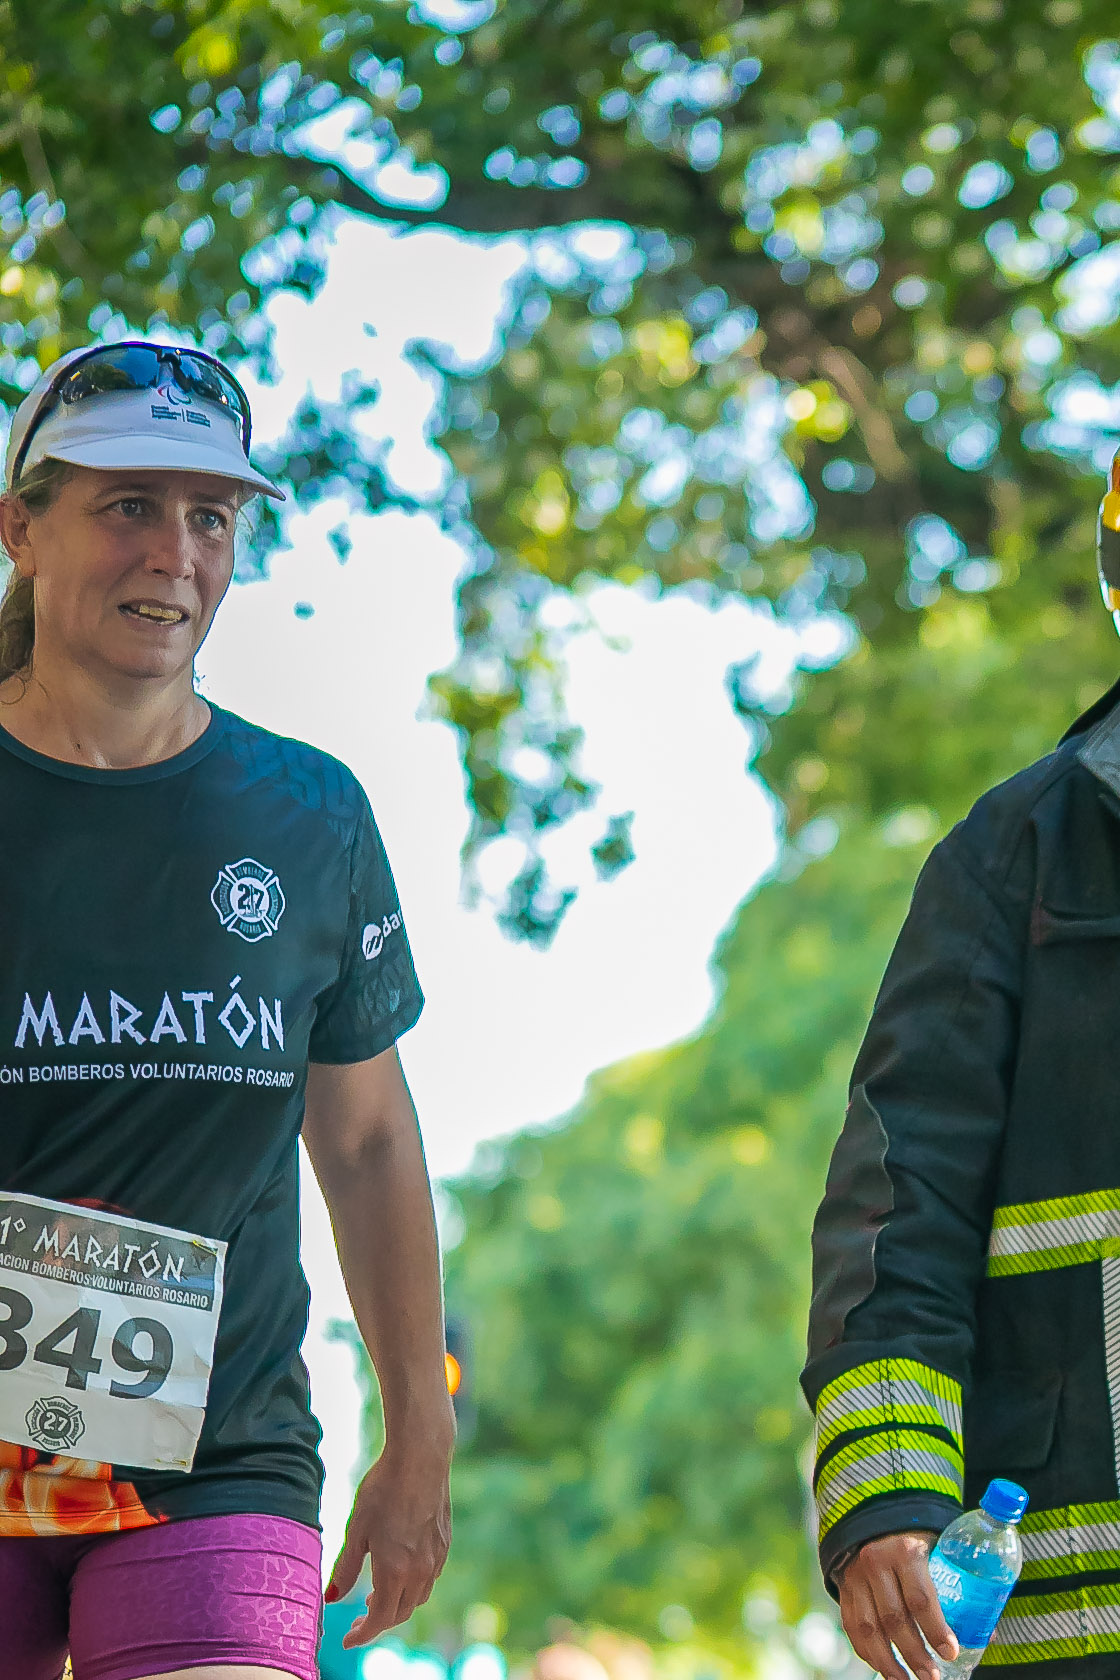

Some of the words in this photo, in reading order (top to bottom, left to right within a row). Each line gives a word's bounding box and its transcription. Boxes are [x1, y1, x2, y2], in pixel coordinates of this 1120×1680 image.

[14, 975, 285, 1051] MARATÓN
[29, 1063, 125, 1083] BOMBEROS
[130, 1062, 243, 1083] VOLUNTARIOS
[246, 1067, 295, 1088] ROSARIO
[33, 1224, 185, 1283] MARATÓN
[31, 1260, 90, 1286] BOMBEROS
[92, 1274, 160, 1299] VOLUNTARIOS
[162, 1287, 209, 1308] ROSARIO
[43, 1411, 69, 1432] 27
